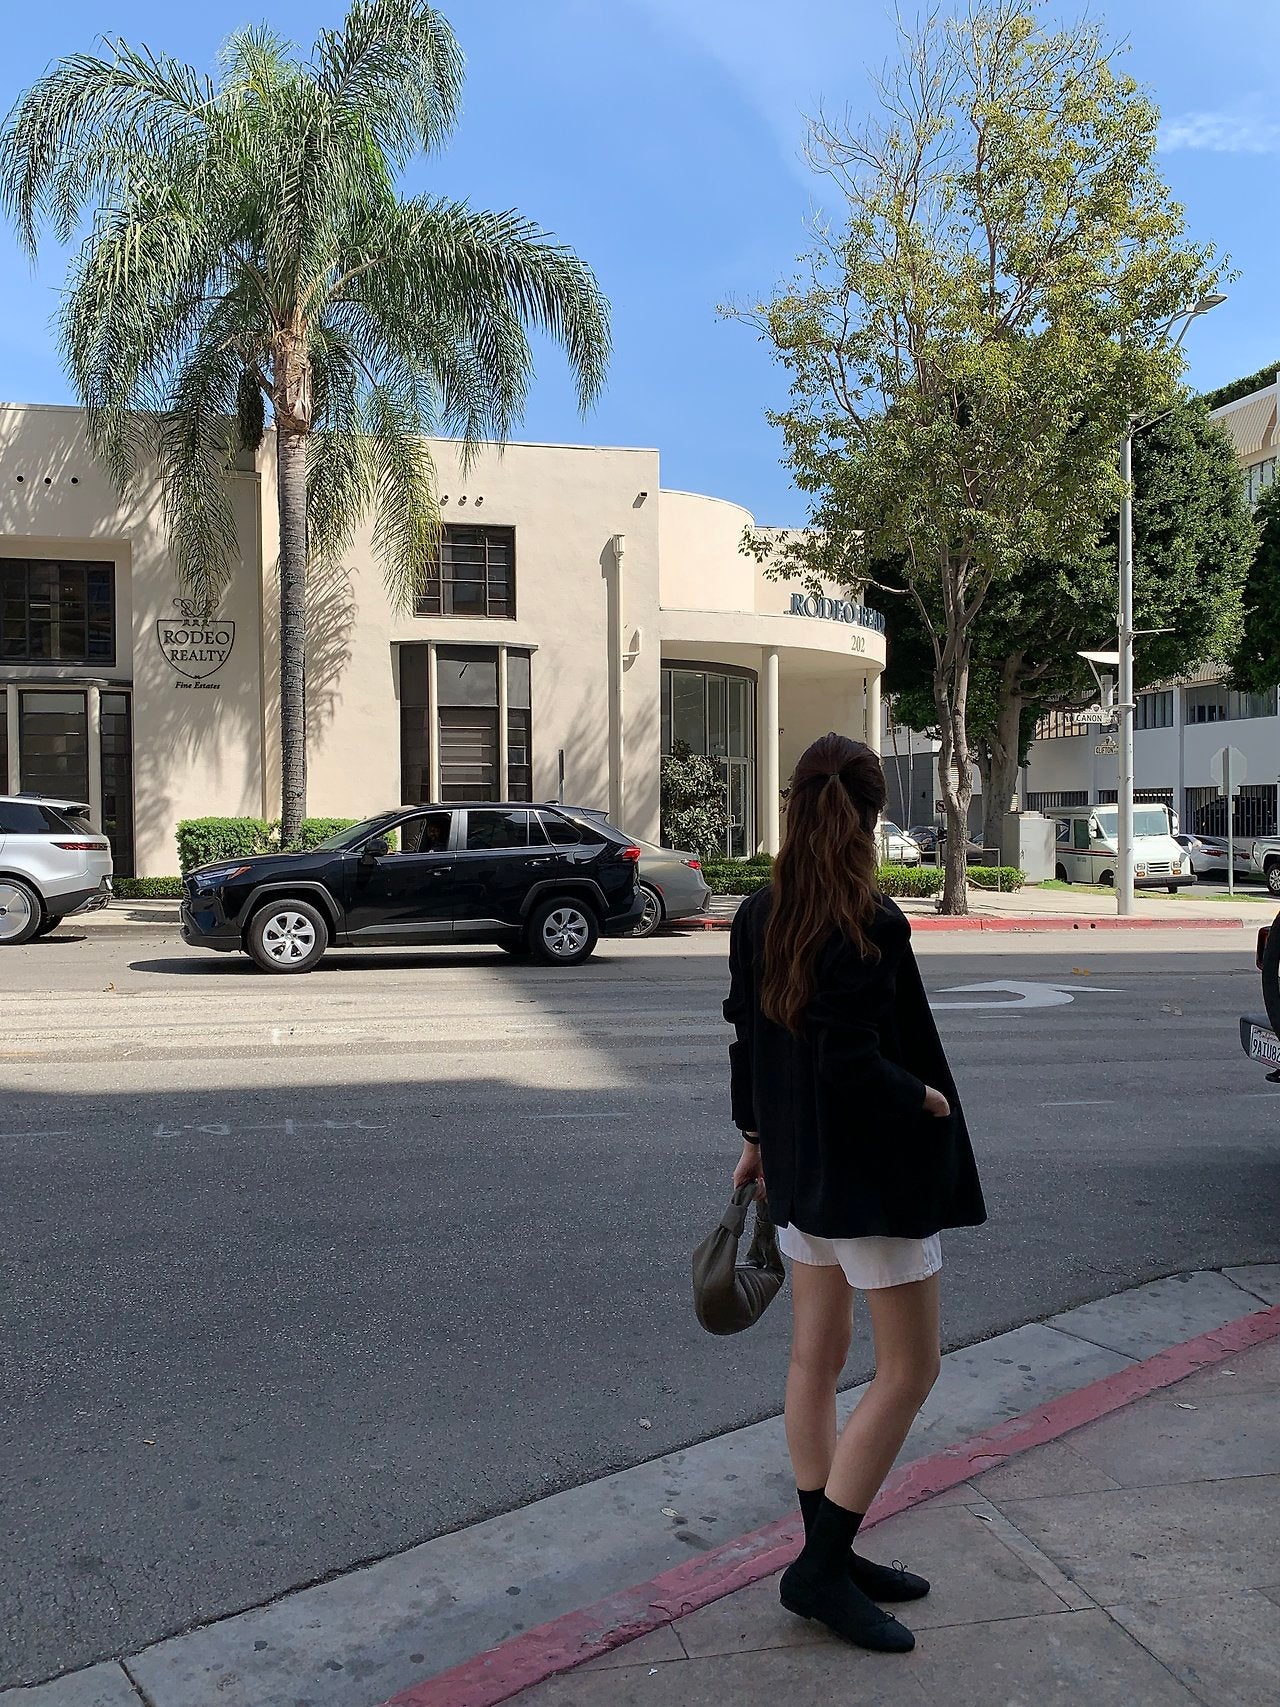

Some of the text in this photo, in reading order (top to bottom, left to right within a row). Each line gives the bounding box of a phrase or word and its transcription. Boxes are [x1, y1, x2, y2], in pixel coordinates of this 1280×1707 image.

[790, 593, 855, 623] RODEO
[163, 630, 230, 645] RODEO
[851, 635, 865, 653] 202
[170, 649, 226, 662] REALTY
[175, 681, 220, 690] Fine Estates
[1076, 714, 1103, 723] CANON
